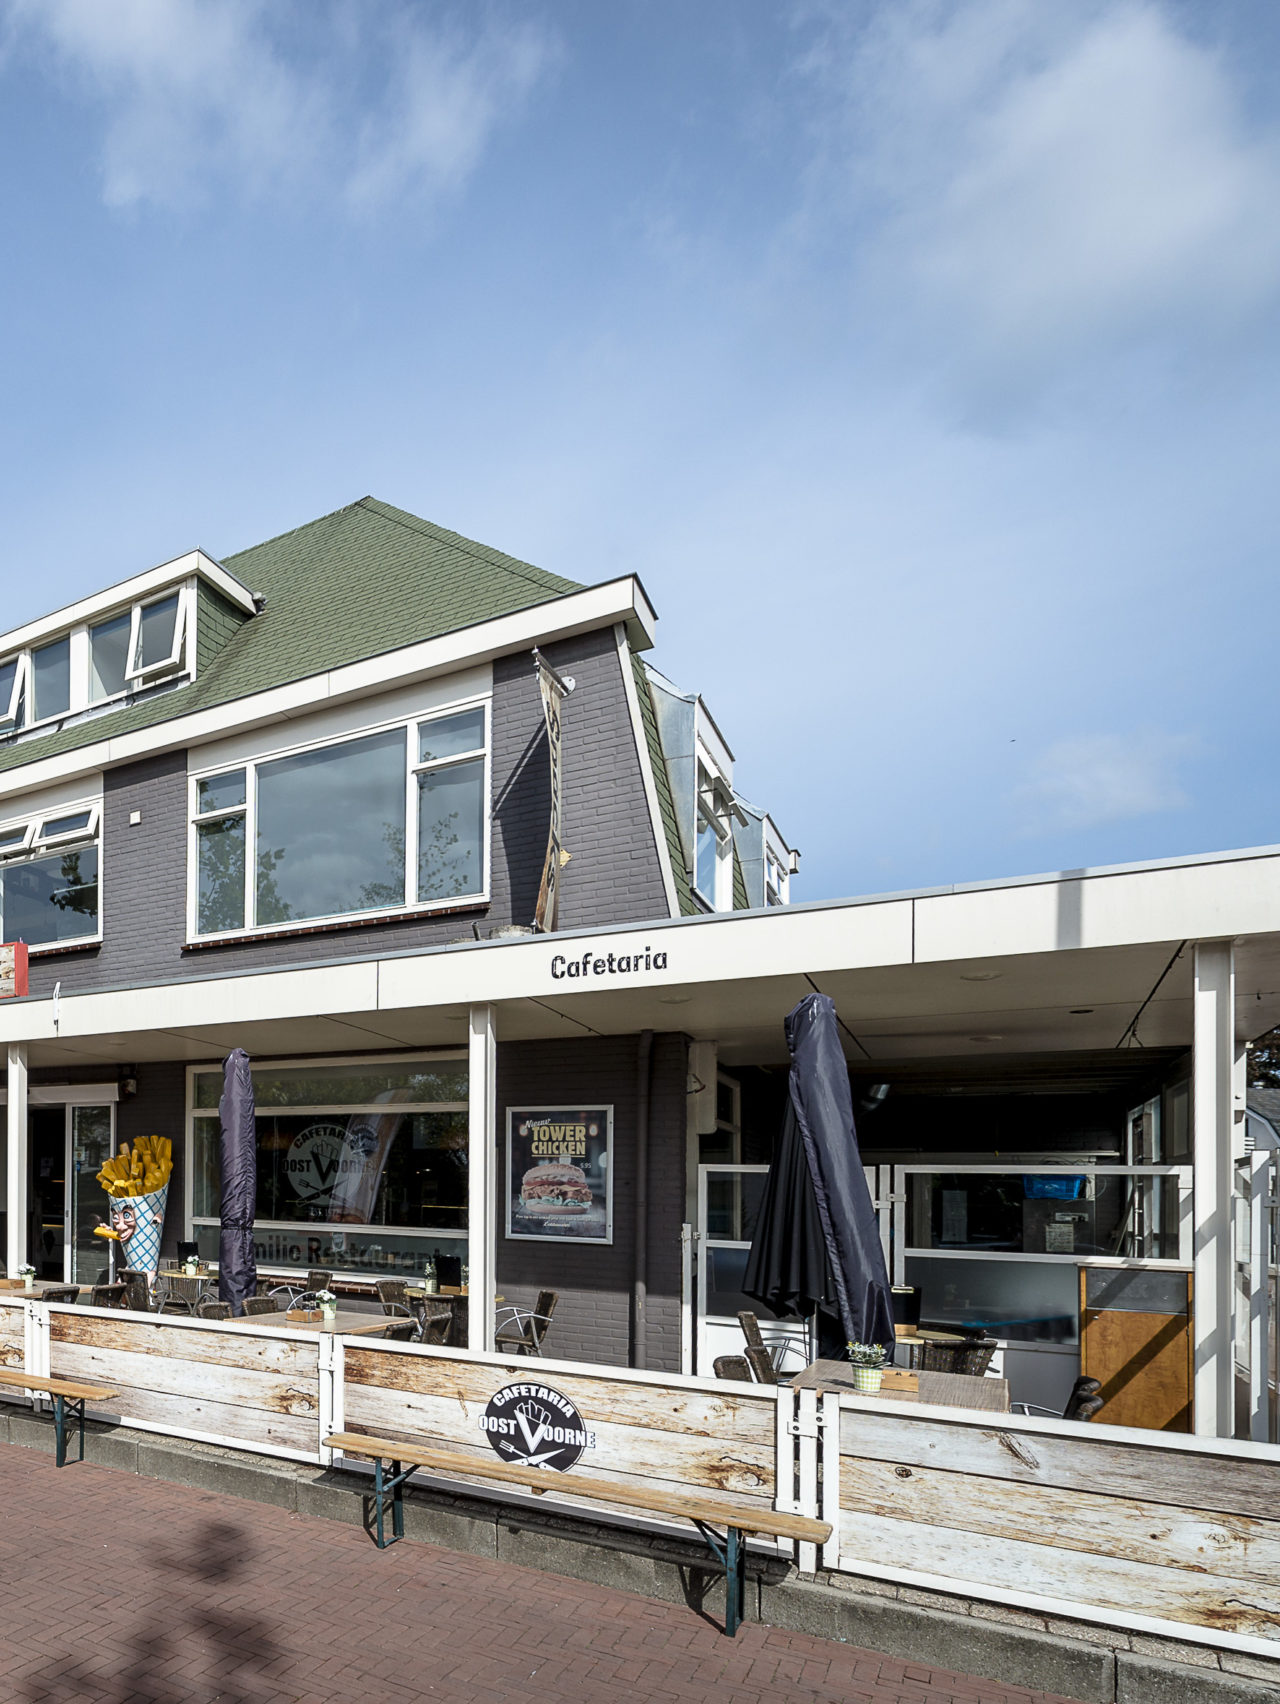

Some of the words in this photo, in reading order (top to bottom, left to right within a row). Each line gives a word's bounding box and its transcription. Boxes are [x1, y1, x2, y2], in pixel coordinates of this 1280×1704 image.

[551, 946, 668, 979] Cafetaria
[531, 1126, 586, 1141] TOWER
[531, 1142, 586, 1155] CHICKEN
[492, 1384, 576, 1418] CAFETARIA
